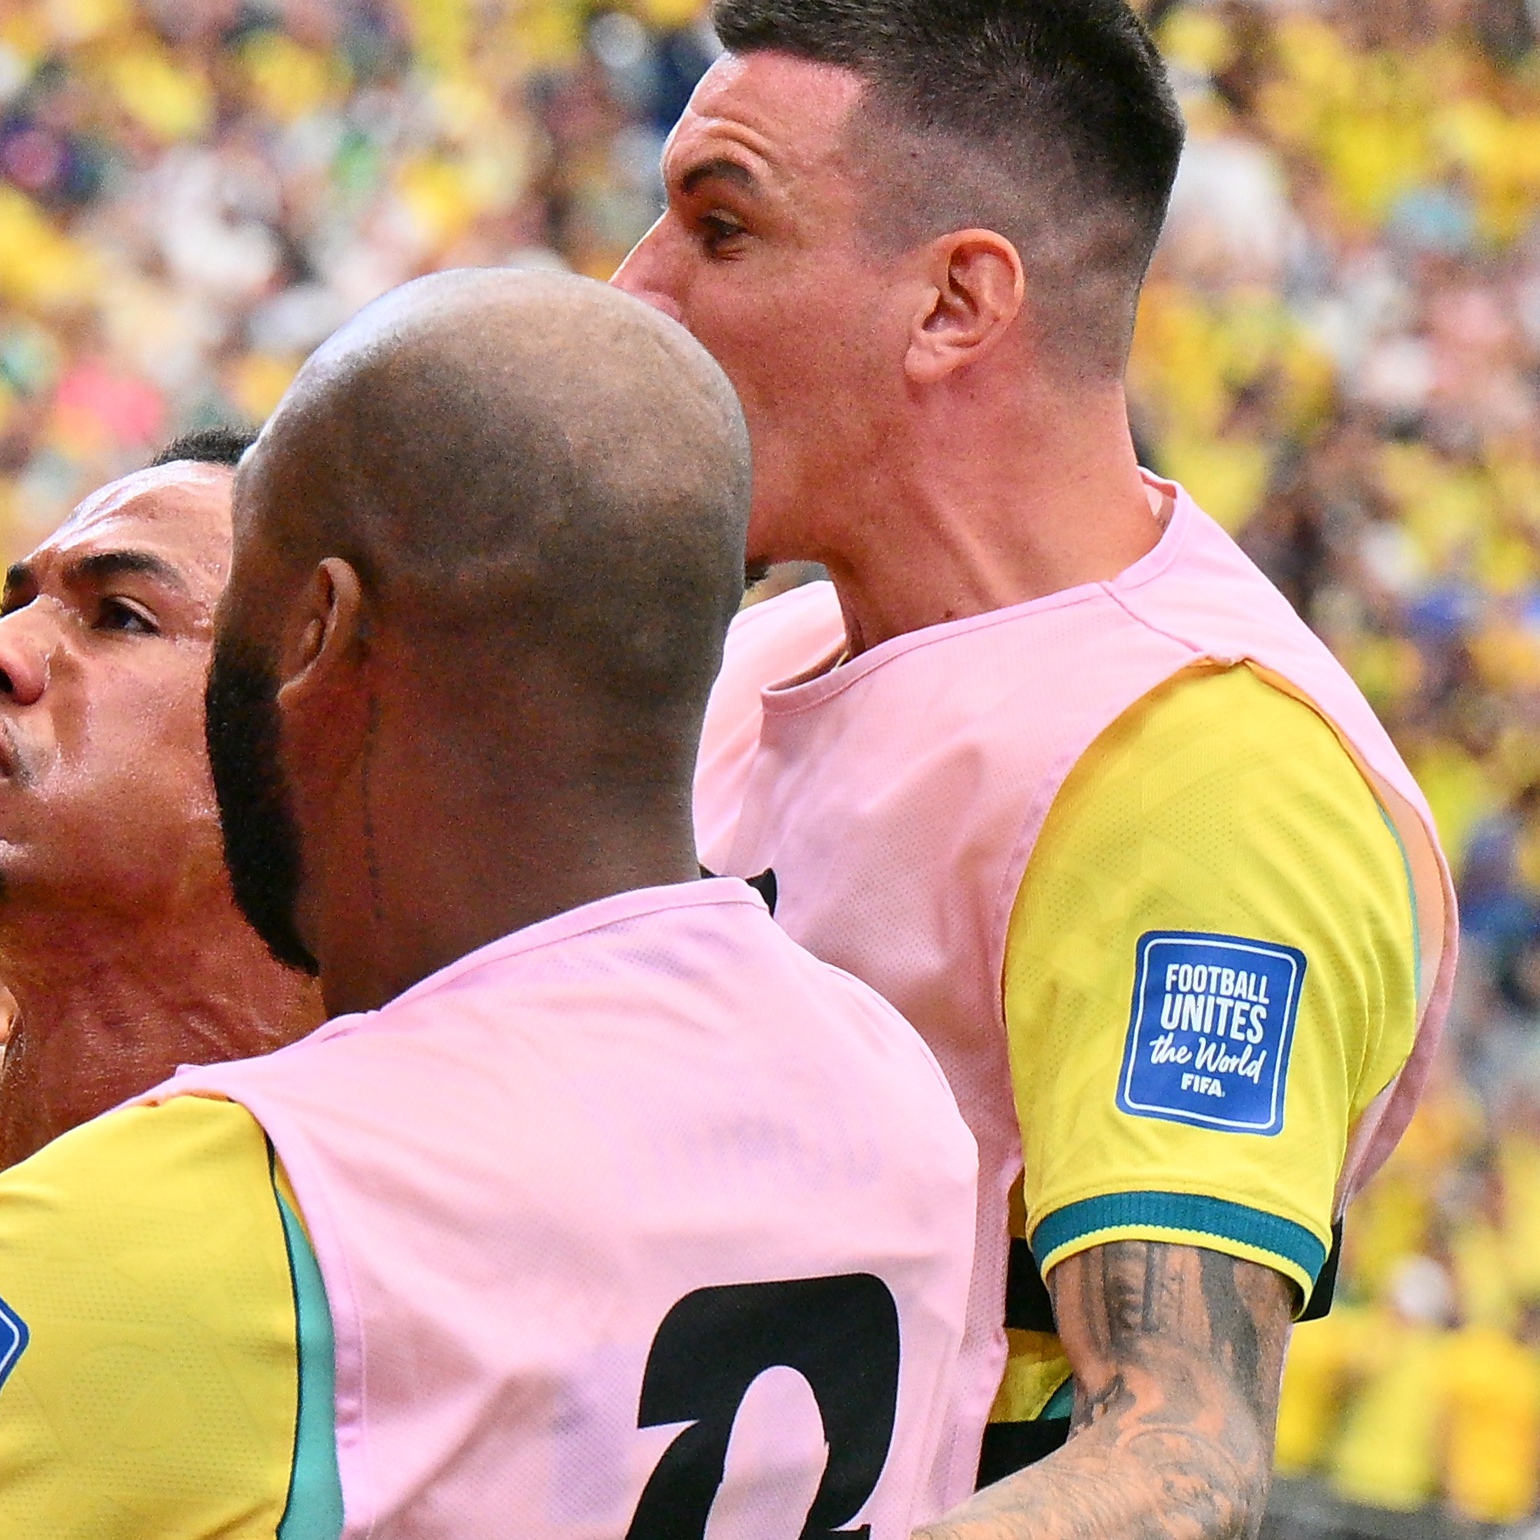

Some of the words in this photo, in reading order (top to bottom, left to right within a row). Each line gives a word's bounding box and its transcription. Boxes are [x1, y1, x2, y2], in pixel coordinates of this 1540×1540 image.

[1165, 964, 1269, 1005] FOOTBALL
[1160, 993, 1267, 1044] UNITES
[1149, 1032, 1193, 1064] the
[1195, 1037, 1267, 1084] World
[1181, 1072, 1222, 1097] FIFA
